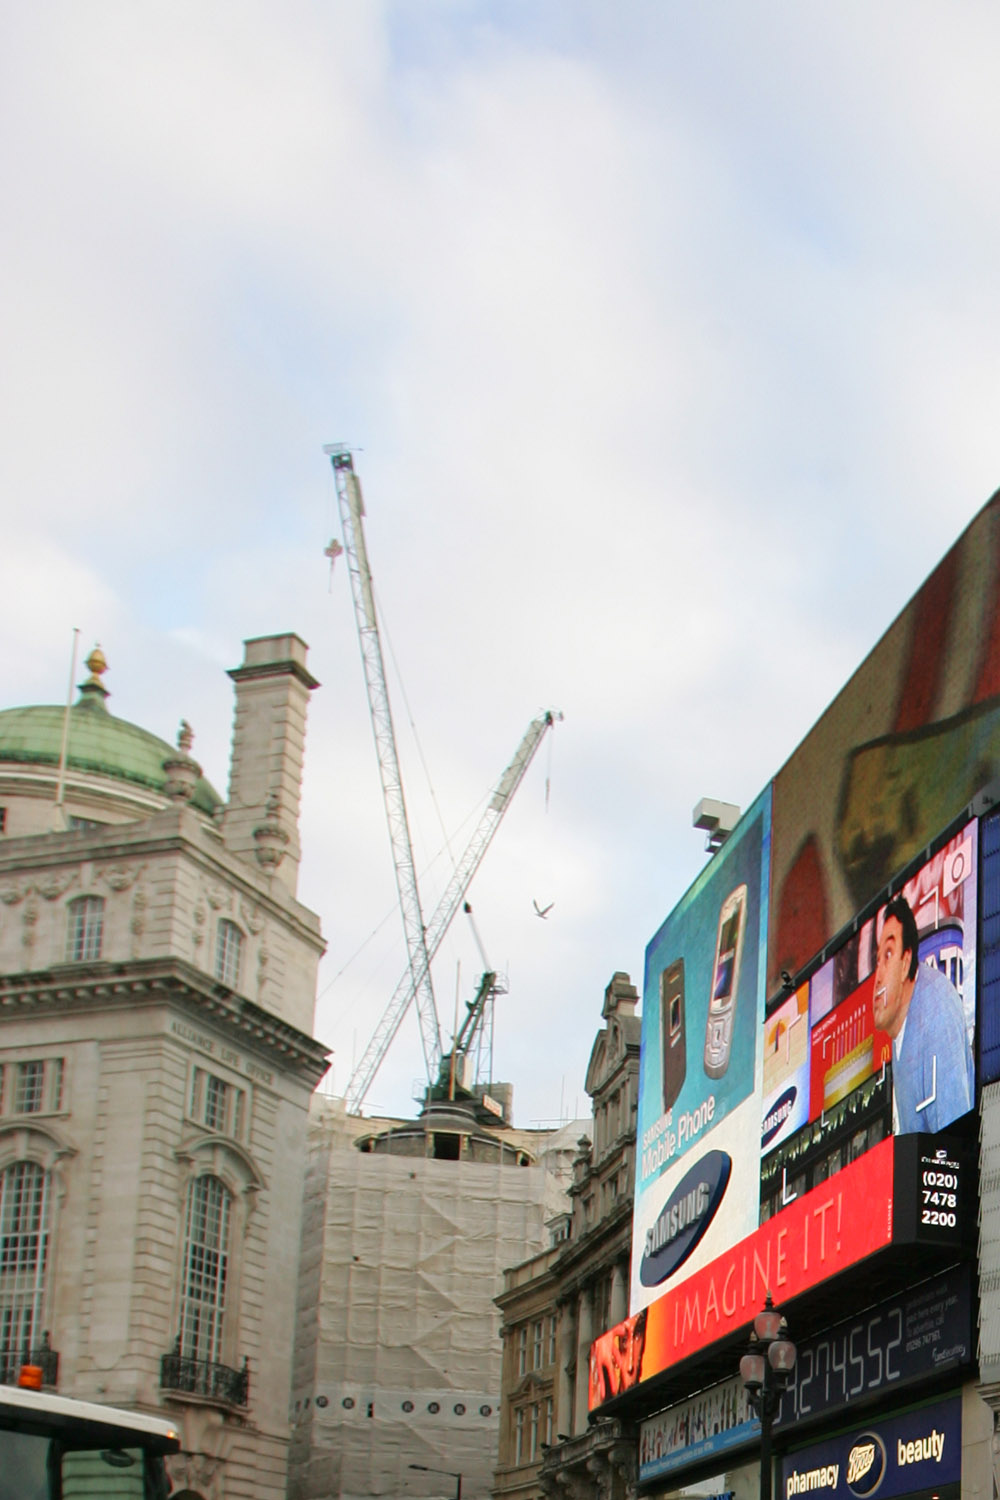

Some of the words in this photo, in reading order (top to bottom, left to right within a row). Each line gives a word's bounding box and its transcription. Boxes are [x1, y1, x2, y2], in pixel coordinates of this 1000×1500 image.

[643, 1108, 673, 1150] SAMSUNG
[761, 1099, 792, 1134] SAMSUNG
[641, 1130, 676, 1182] Mobile
[678, 1095, 716, 1149] Phone
[921, 1190, 957, 1208] 7478
[922, 1171, 958, 1190] (020)
[645, 1182, 710, 1258] SAMSUNG
[921, 1209, 957, 1228] 2200
[674, 1228, 788, 1347] IMAGINE
[803, 1192, 843, 1272] IT!
[846, 1443, 875, 1485] Boots
[897, 1429, 945, 1467] beauty
[786, 1463, 840, 1500] pharmacy
